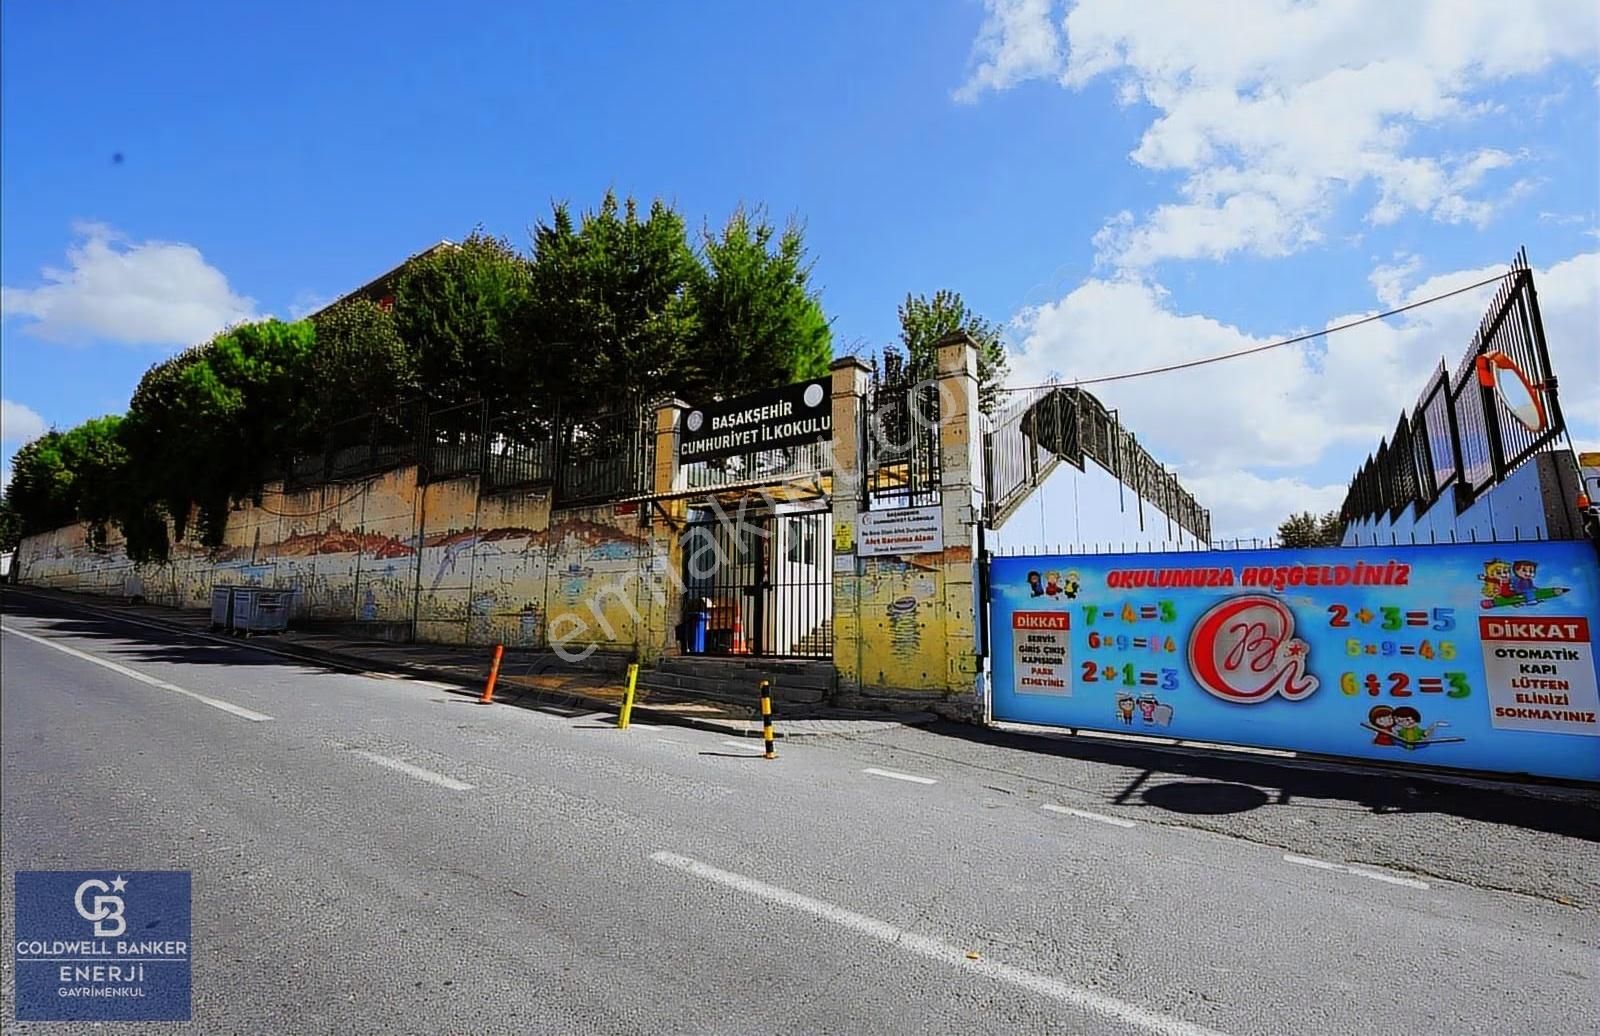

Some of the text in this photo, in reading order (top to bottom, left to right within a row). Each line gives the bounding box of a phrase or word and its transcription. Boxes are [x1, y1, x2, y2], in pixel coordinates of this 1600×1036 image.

[711, 399, 793, 430] BAŞAKŞEHİR
[681, 415, 831, 456] CUMHURİYET İLKOKULU
[1107, 560, 1411, 593] OKULUMUZA HOŞGELDİNİZ
[1017, 613, 1065, 628] DİKKAT
[1488, 620, 1579, 640] DİKKAT
[1027, 634, 1056, 643] SERVİS
[1495, 648, 1580, 661] OTOMATİK
[1031, 667, 1053, 676] PARK
[1519, 664, 1557, 675] KAPI
[1021, 677, 1065, 688] ETMEYİNİZ
[1511, 677, 1569, 690] LÜTFEN
[1516, 692, 1569, 706] ELİNİZİ
[1495, 707, 1597, 723] SOKMAYINIZ
